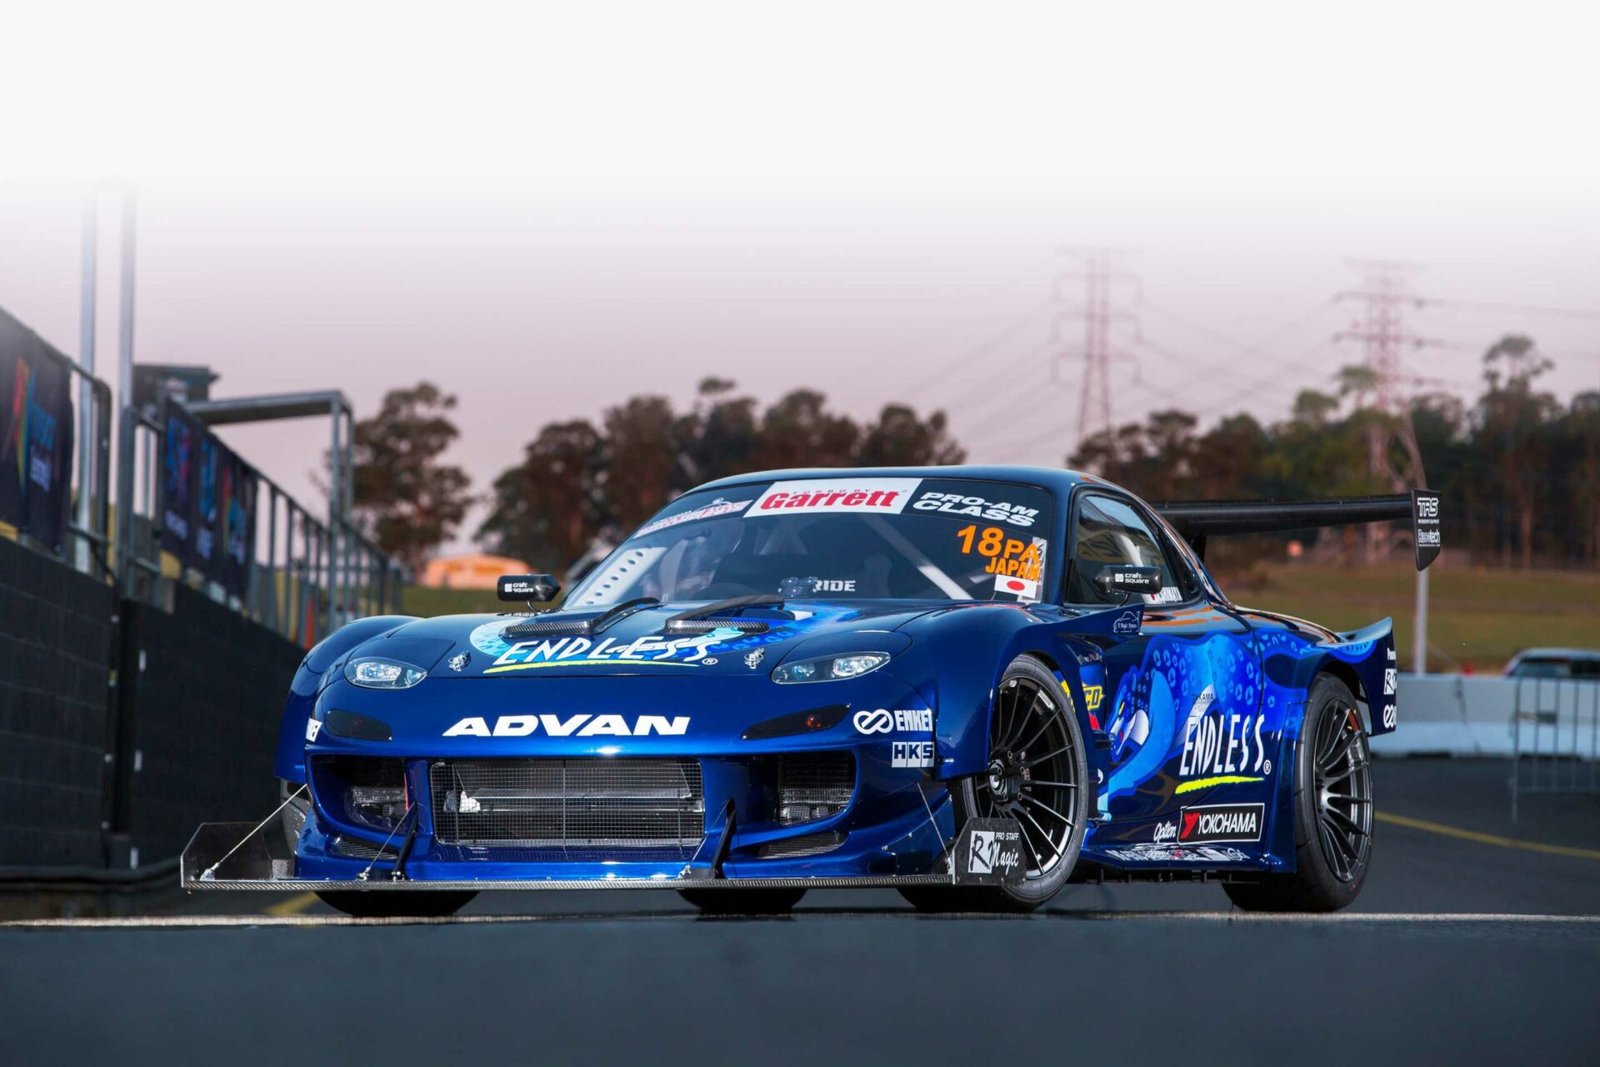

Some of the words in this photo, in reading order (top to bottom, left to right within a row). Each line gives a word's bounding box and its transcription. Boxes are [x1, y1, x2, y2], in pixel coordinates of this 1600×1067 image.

[760, 490, 900, 510] Garrett
[920, 492, 1039, 517] PRO-AM
[913, 500, 1035, 527] CLASS
[985, 556, 1040, 582] JAPAN
[492, 636, 722, 666] ENDLESS
[442, 714, 691, 737] ADVAN
[893, 743, 934, 760] HKS
[1179, 714, 1265, 776] ENDLESS
[1153, 821, 1178, 844] Option
[1198, 812, 1257, 835] YOKOHAMA
[995, 832, 1005, 840] PRO
[1006, 833, 1019, 841] STAFF
